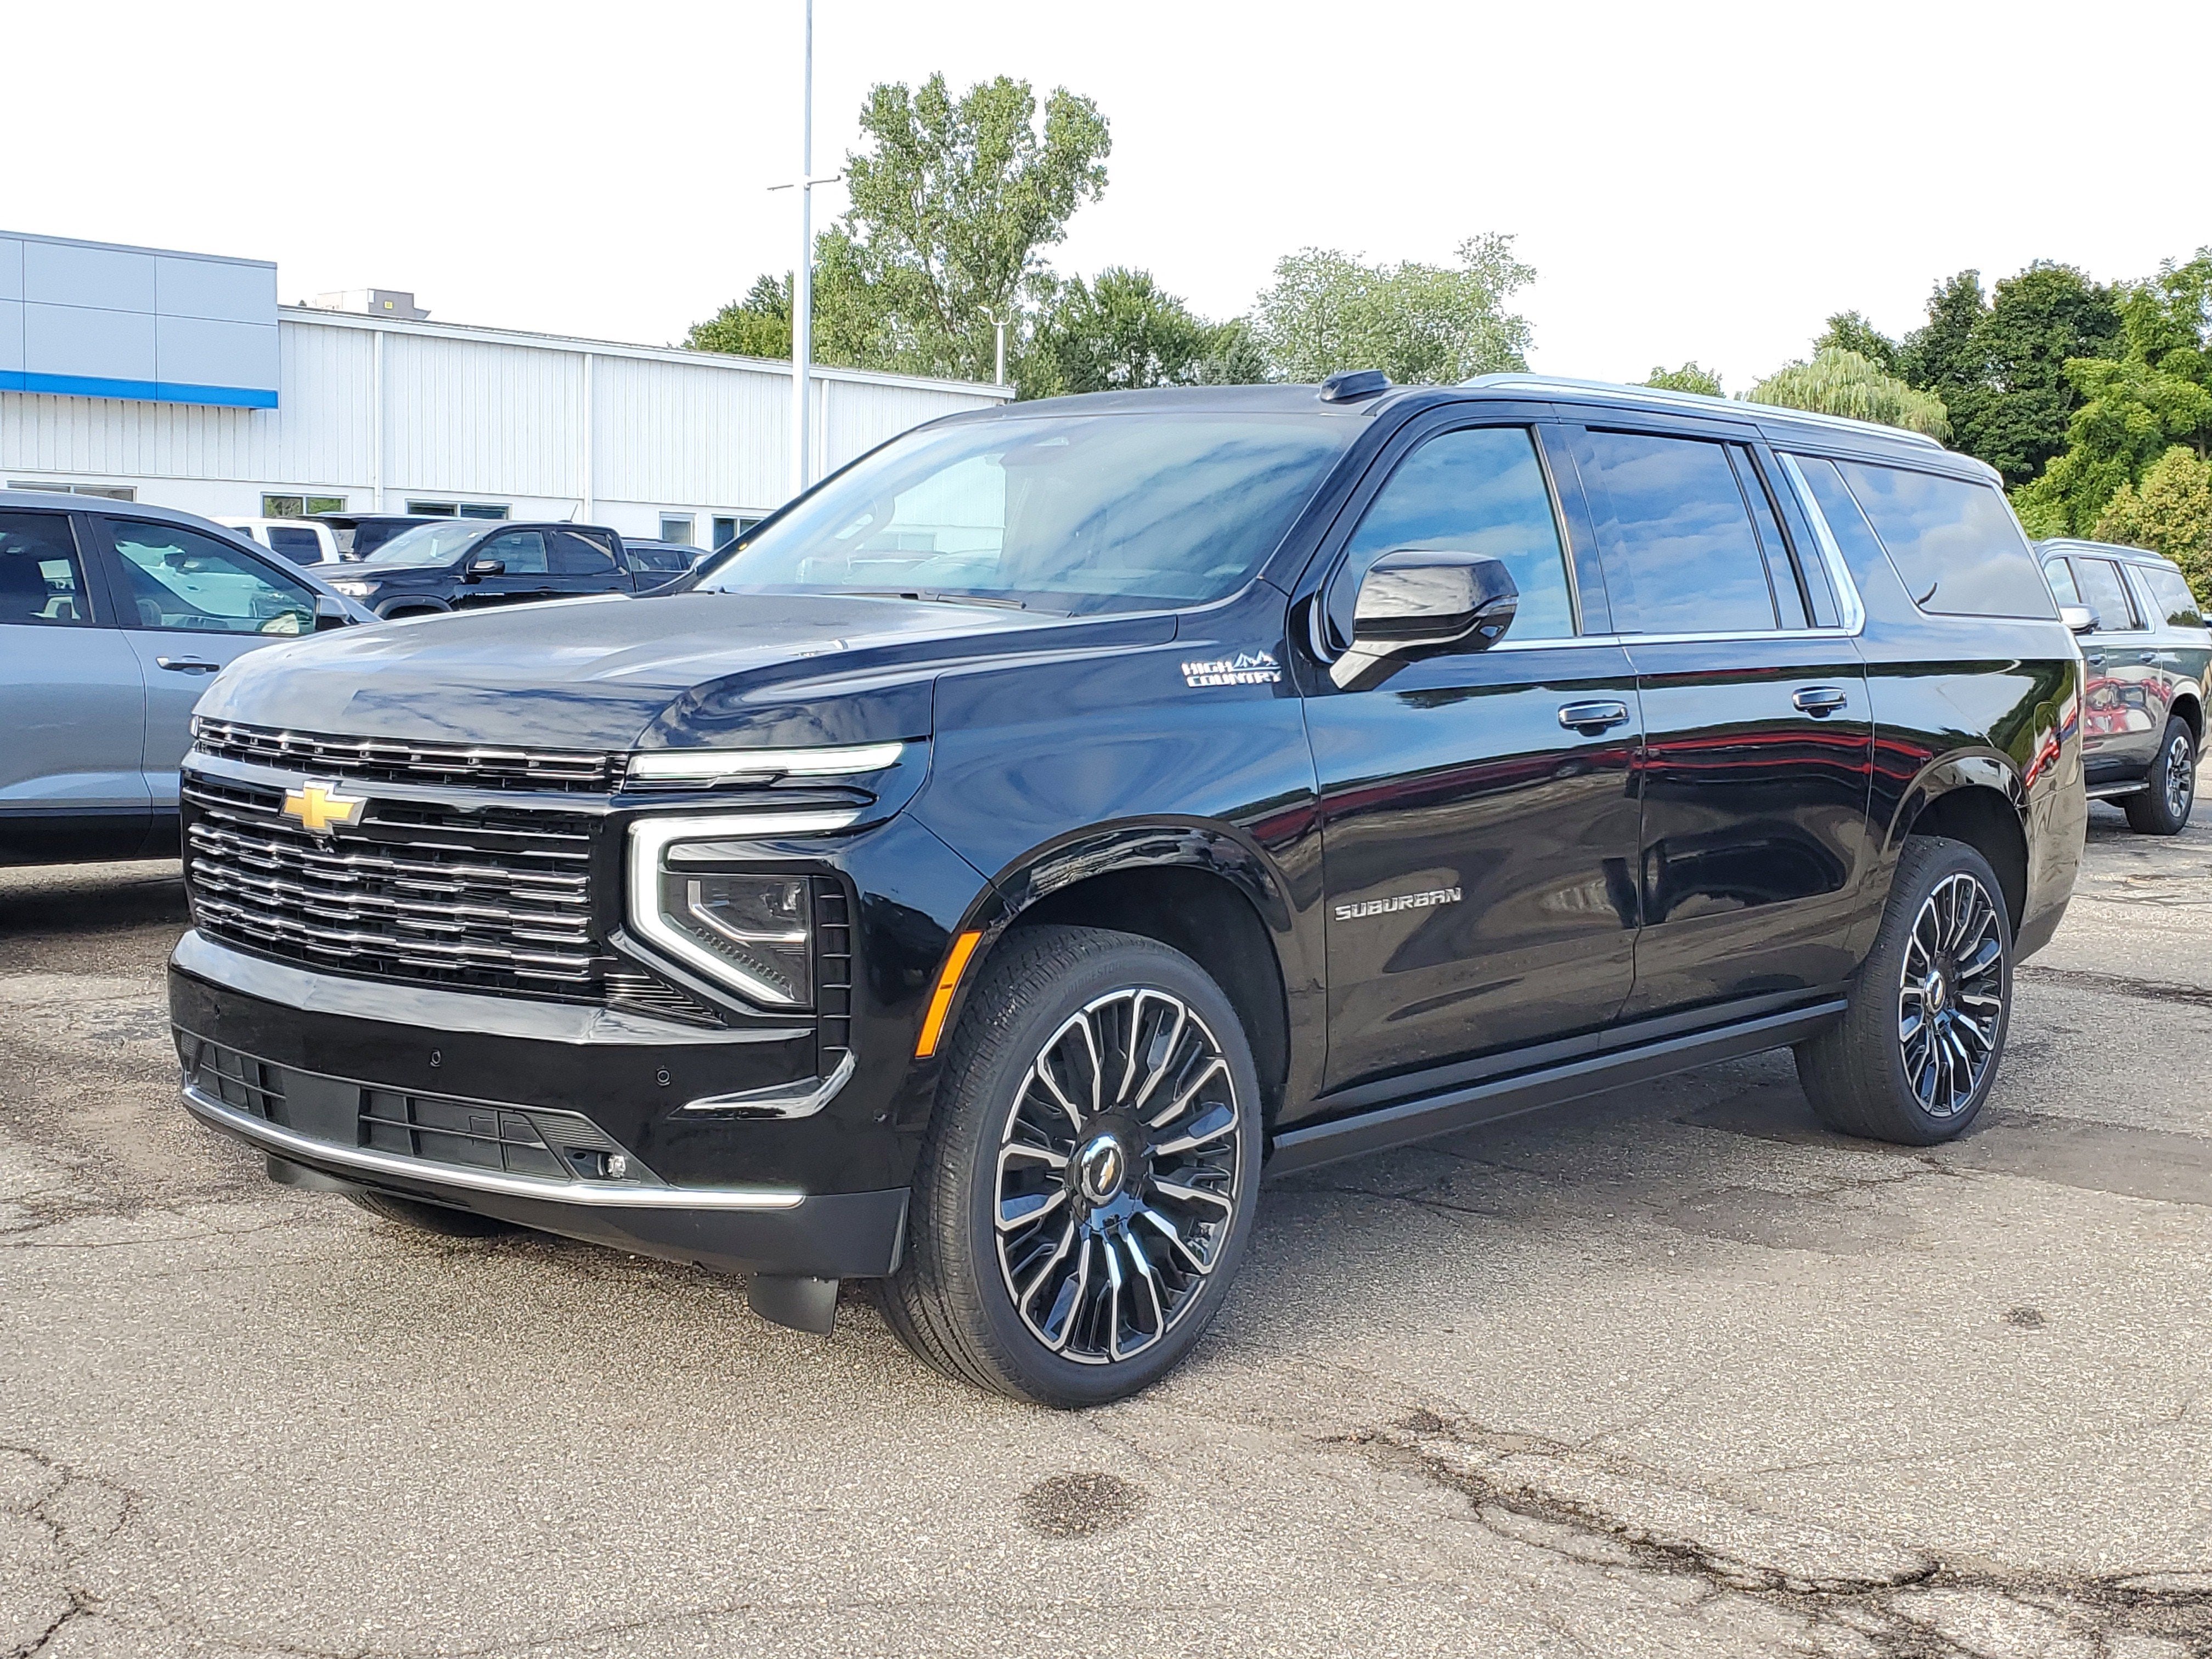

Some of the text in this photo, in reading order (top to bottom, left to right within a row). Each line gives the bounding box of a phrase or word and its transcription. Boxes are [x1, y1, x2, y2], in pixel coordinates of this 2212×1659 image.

[1181, 661, 1234, 675] HIGH
[1187, 670, 1281, 687] COUNTRY
[1335, 887, 1462, 921] SUBURBAN
